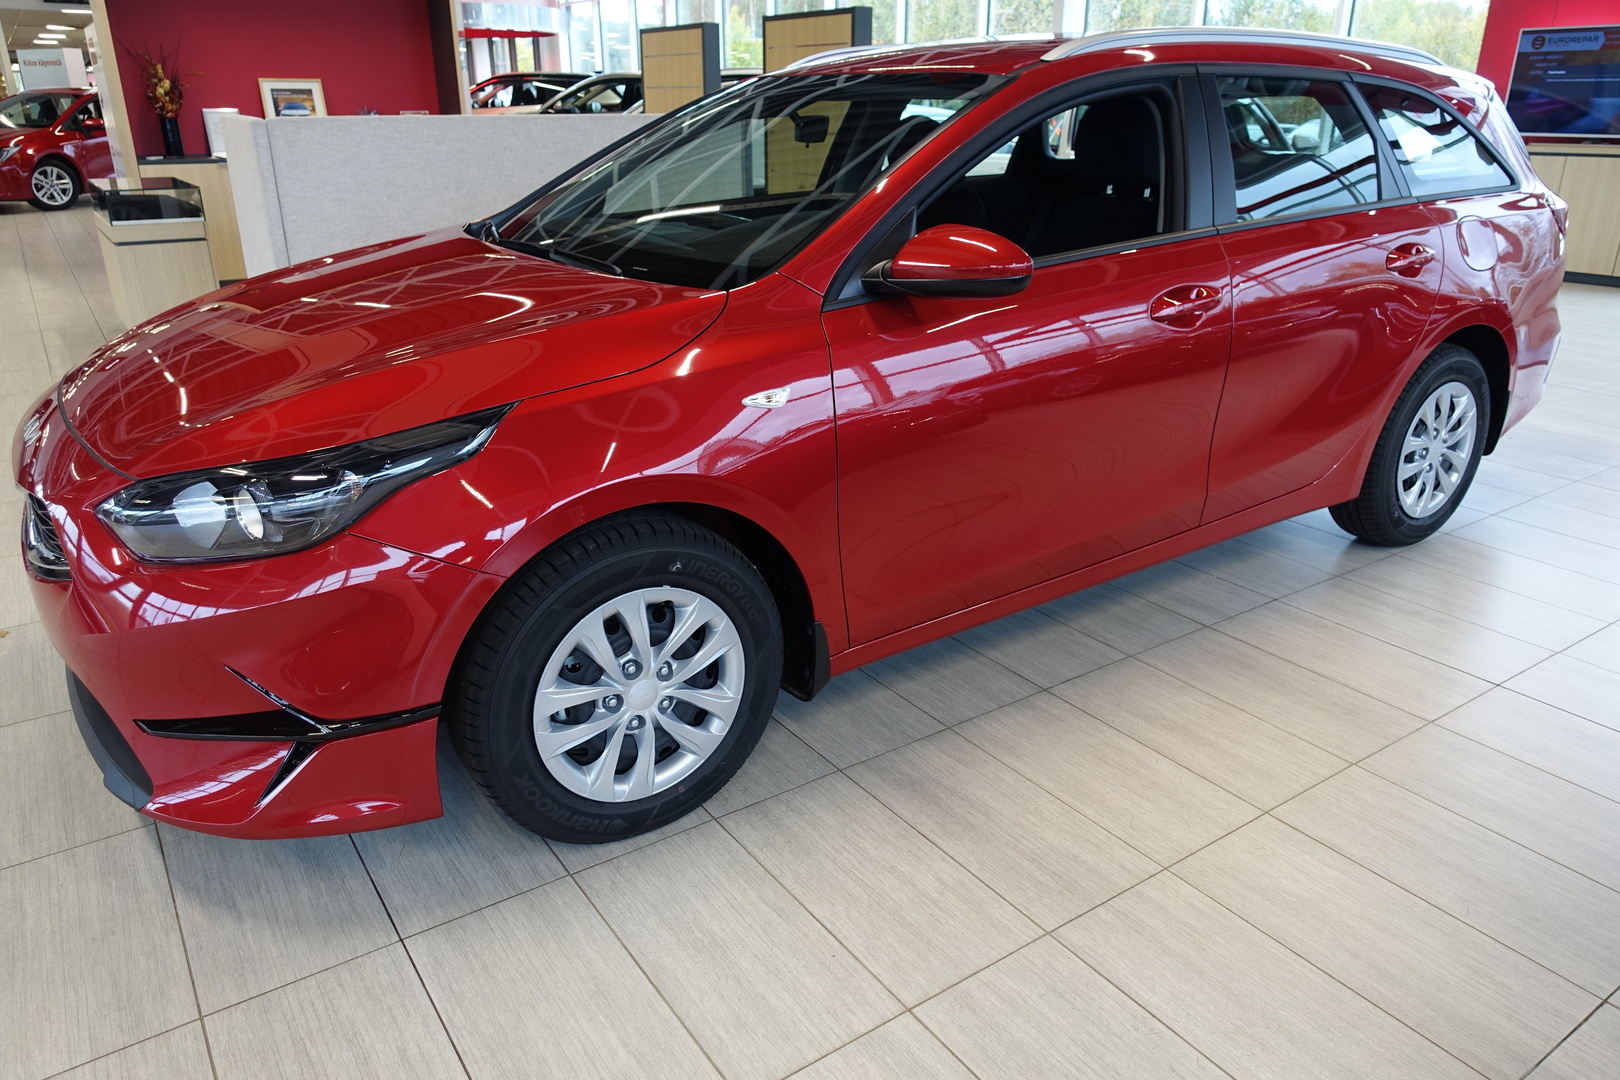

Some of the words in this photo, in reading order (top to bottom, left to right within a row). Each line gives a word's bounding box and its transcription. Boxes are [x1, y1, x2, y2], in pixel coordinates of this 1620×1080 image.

[1547, 35, 1600, 44] EUROREPAR
[23, 59, 37, 67] Kiitos
[38, 58, 62, 68] käynnistä
[671, 557, 748, 597] KINERGY
[741, 597, 758, 618] ECO
